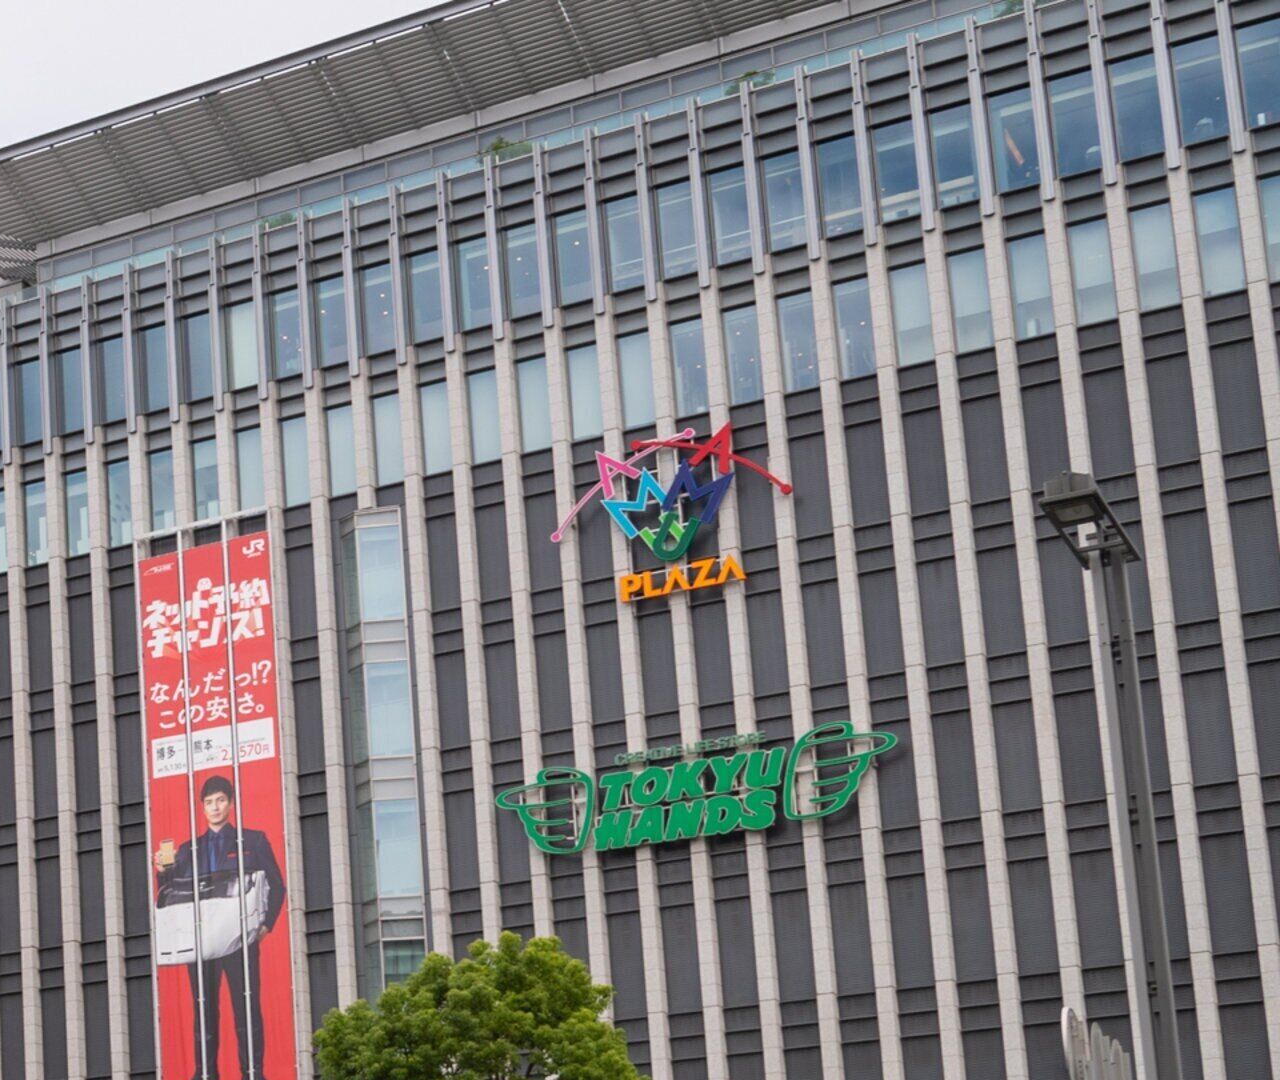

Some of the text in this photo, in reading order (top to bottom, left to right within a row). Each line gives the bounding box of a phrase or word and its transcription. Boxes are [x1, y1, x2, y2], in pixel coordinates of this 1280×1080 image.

[242, 539, 265, 554] JR
[143, 577, 270, 630] ネット予約
[619, 553, 746, 603] PLAZA
[146, 607, 265, 659] チャンス!
[159, 692, 265, 729] この安さ。
[599, 746, 786, 811] TOKYU
[593, 789, 777, 851] HANDS
